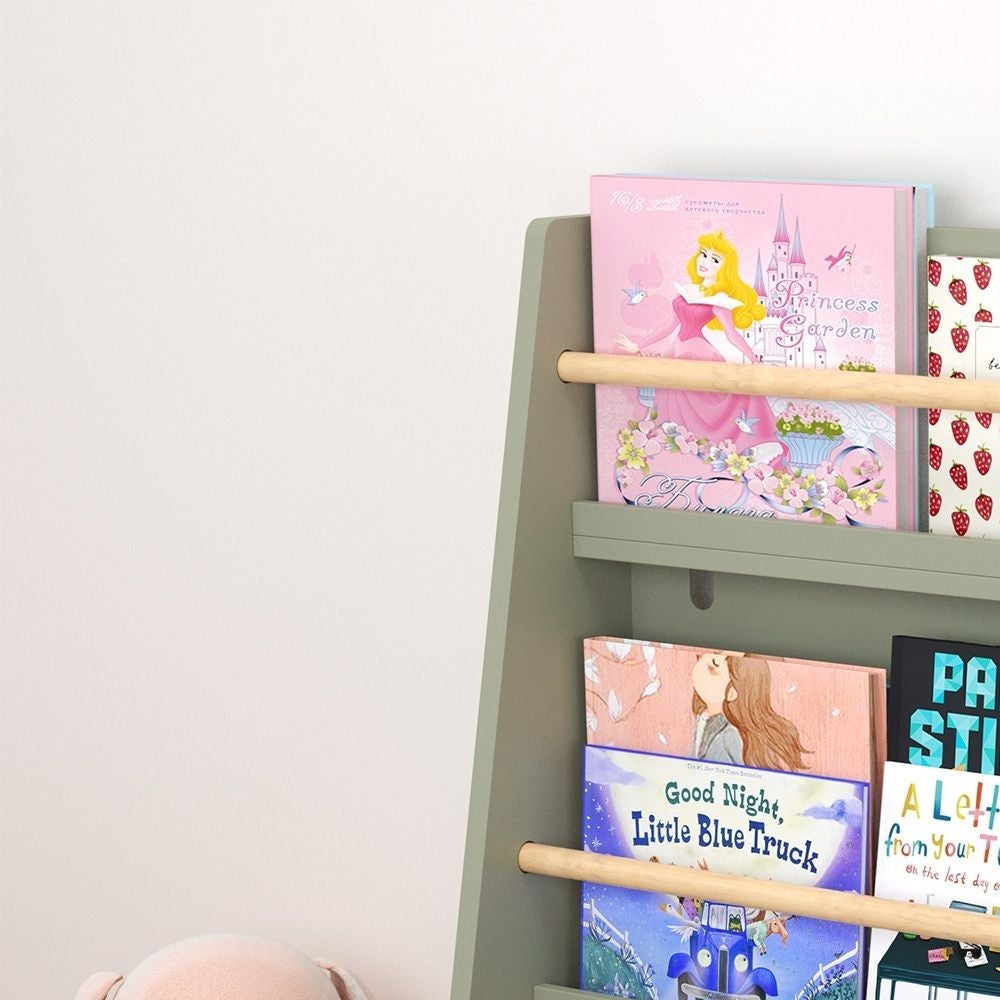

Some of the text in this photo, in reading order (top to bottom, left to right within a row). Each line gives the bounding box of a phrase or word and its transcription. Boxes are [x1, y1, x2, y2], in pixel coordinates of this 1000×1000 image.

[772, 280, 879, 312] Princess
[775, 314, 876, 348] Garden
[665, 780, 784, 825] Good Night,
[901, 783, 920, 819] A
[631, 810, 819, 874] Little Blue Truck
[884, 822, 928, 857] from
[922, 865, 939, 880] the
[944, 866, 967, 885] last
[972, 874, 989, 893] day
